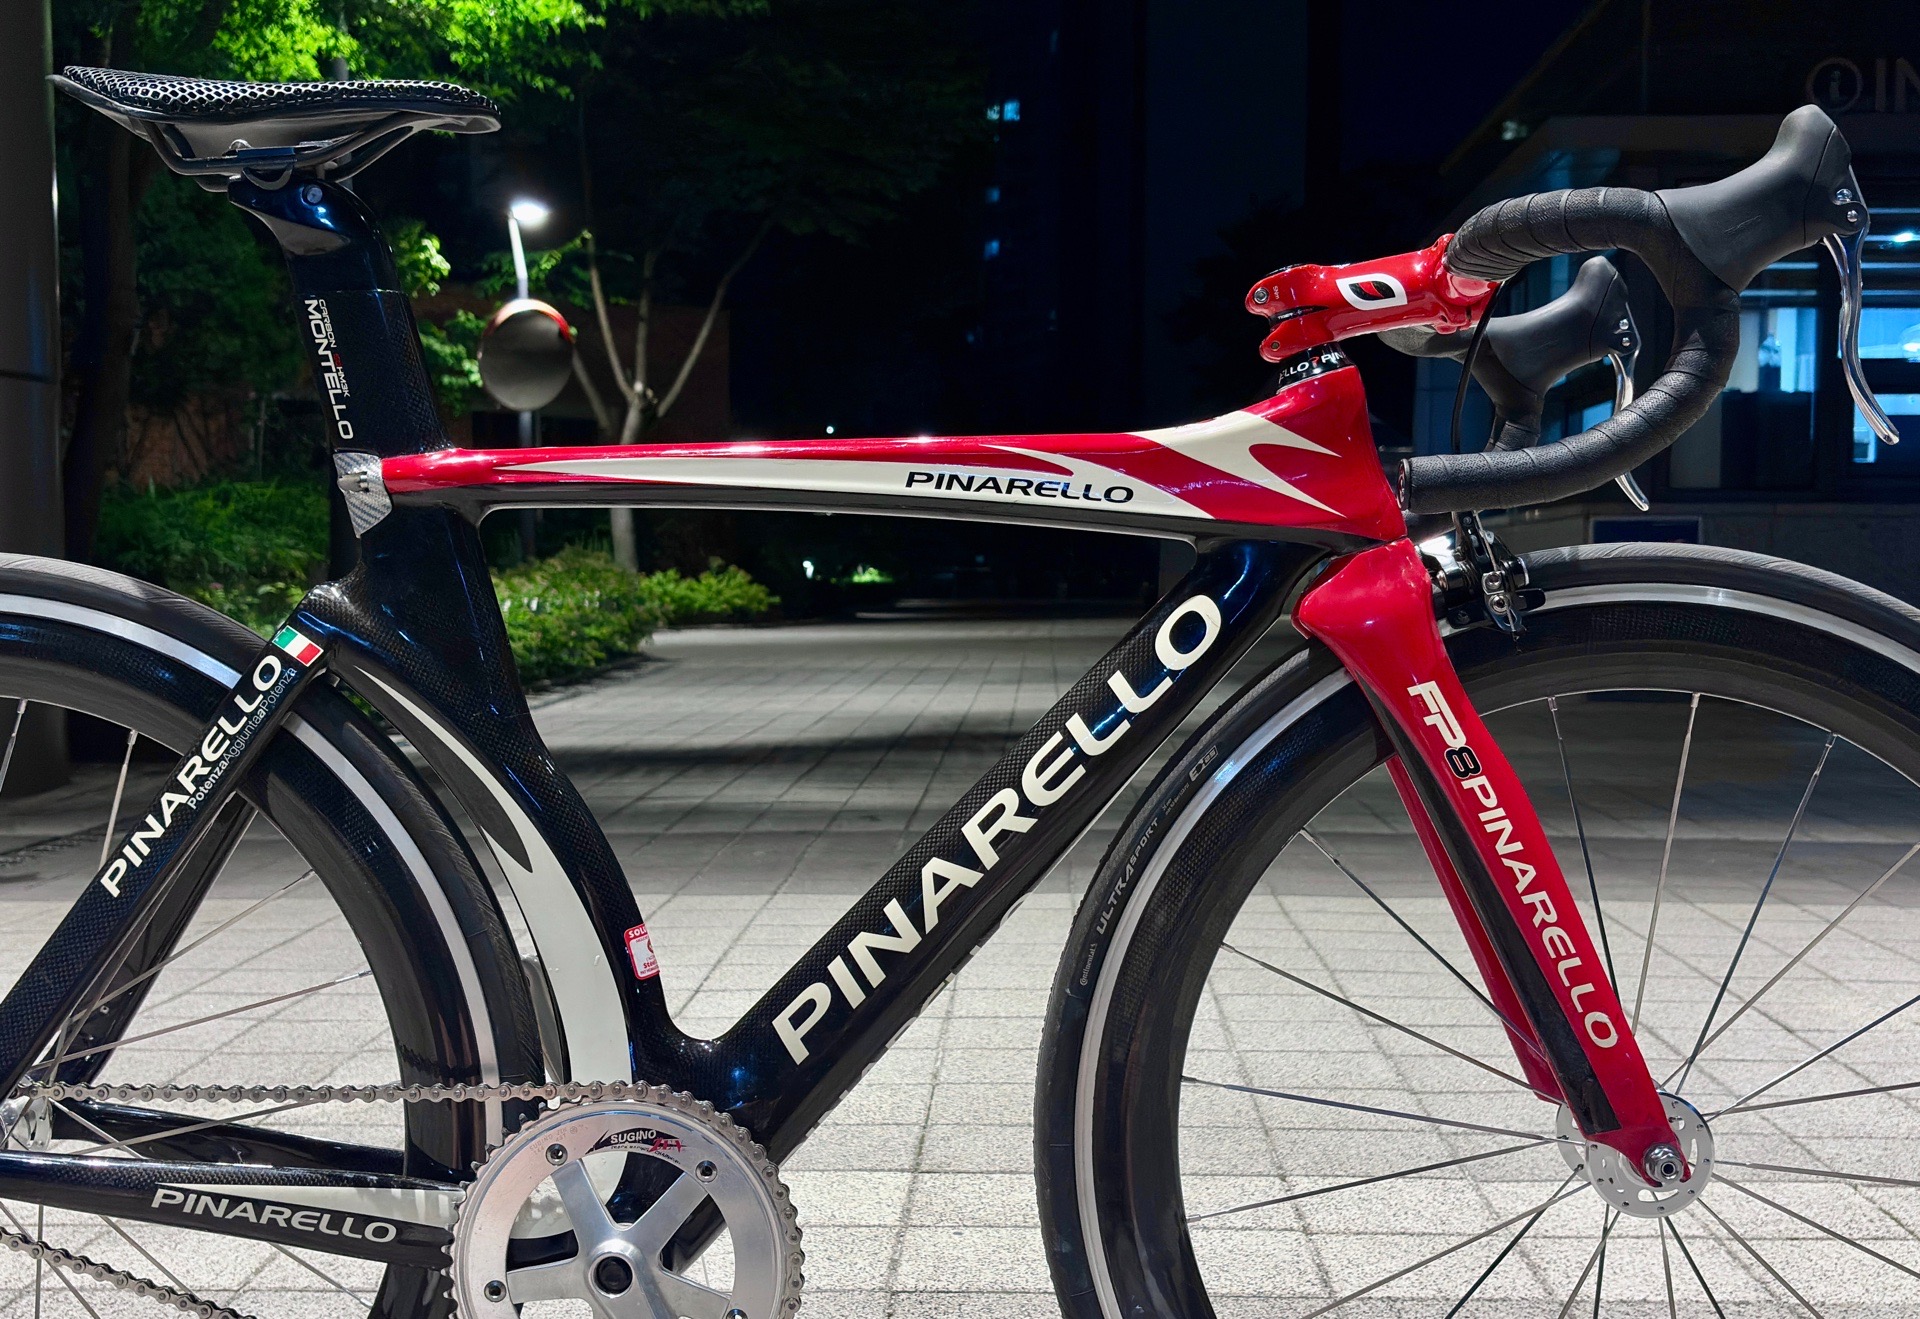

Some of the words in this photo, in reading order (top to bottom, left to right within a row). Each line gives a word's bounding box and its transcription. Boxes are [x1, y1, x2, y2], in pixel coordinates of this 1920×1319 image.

[319, 299, 337, 348] CARBON
[304, 299, 354, 440] MONTELLO
[905, 471, 1134, 504] PINARELLO
[100, 655, 282, 898] PINARELLO
[772, 594, 1222, 1066] PINARELLO
[1407, 680, 1482, 780] FP8
[1461, 776, 1618, 1049] PINARELLO
[1079, 947, 1097, 986] Continental
[610, 1129, 657, 1144] SUGINO
[151, 1188, 397, 1243] PINARELLO
